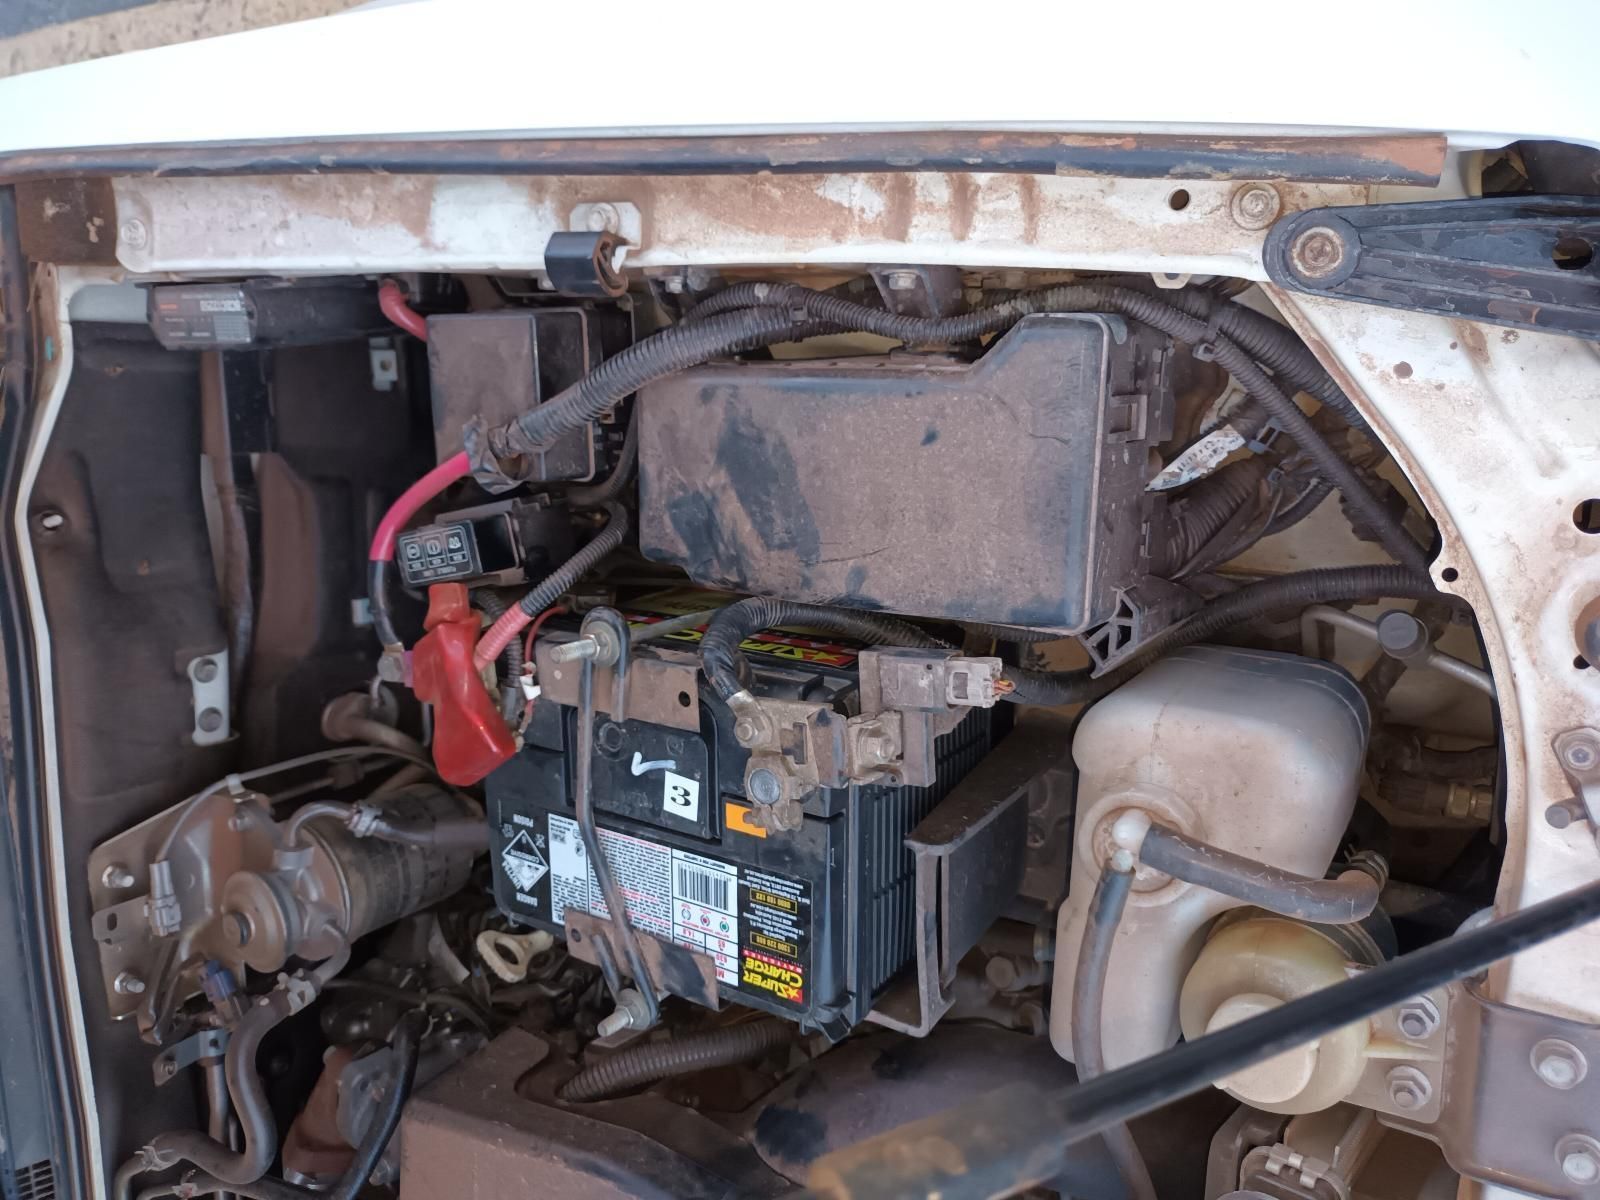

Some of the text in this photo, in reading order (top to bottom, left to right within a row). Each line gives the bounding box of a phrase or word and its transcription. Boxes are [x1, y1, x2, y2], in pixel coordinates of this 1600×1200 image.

[670, 785, 691, 806] 3
[510, 849, 539, 864] CORROSIVE
[744, 950, 802, 973] BATTERIES
[745, 957, 803, 987] CHARGE
[743, 970, 788, 999] SUPER
